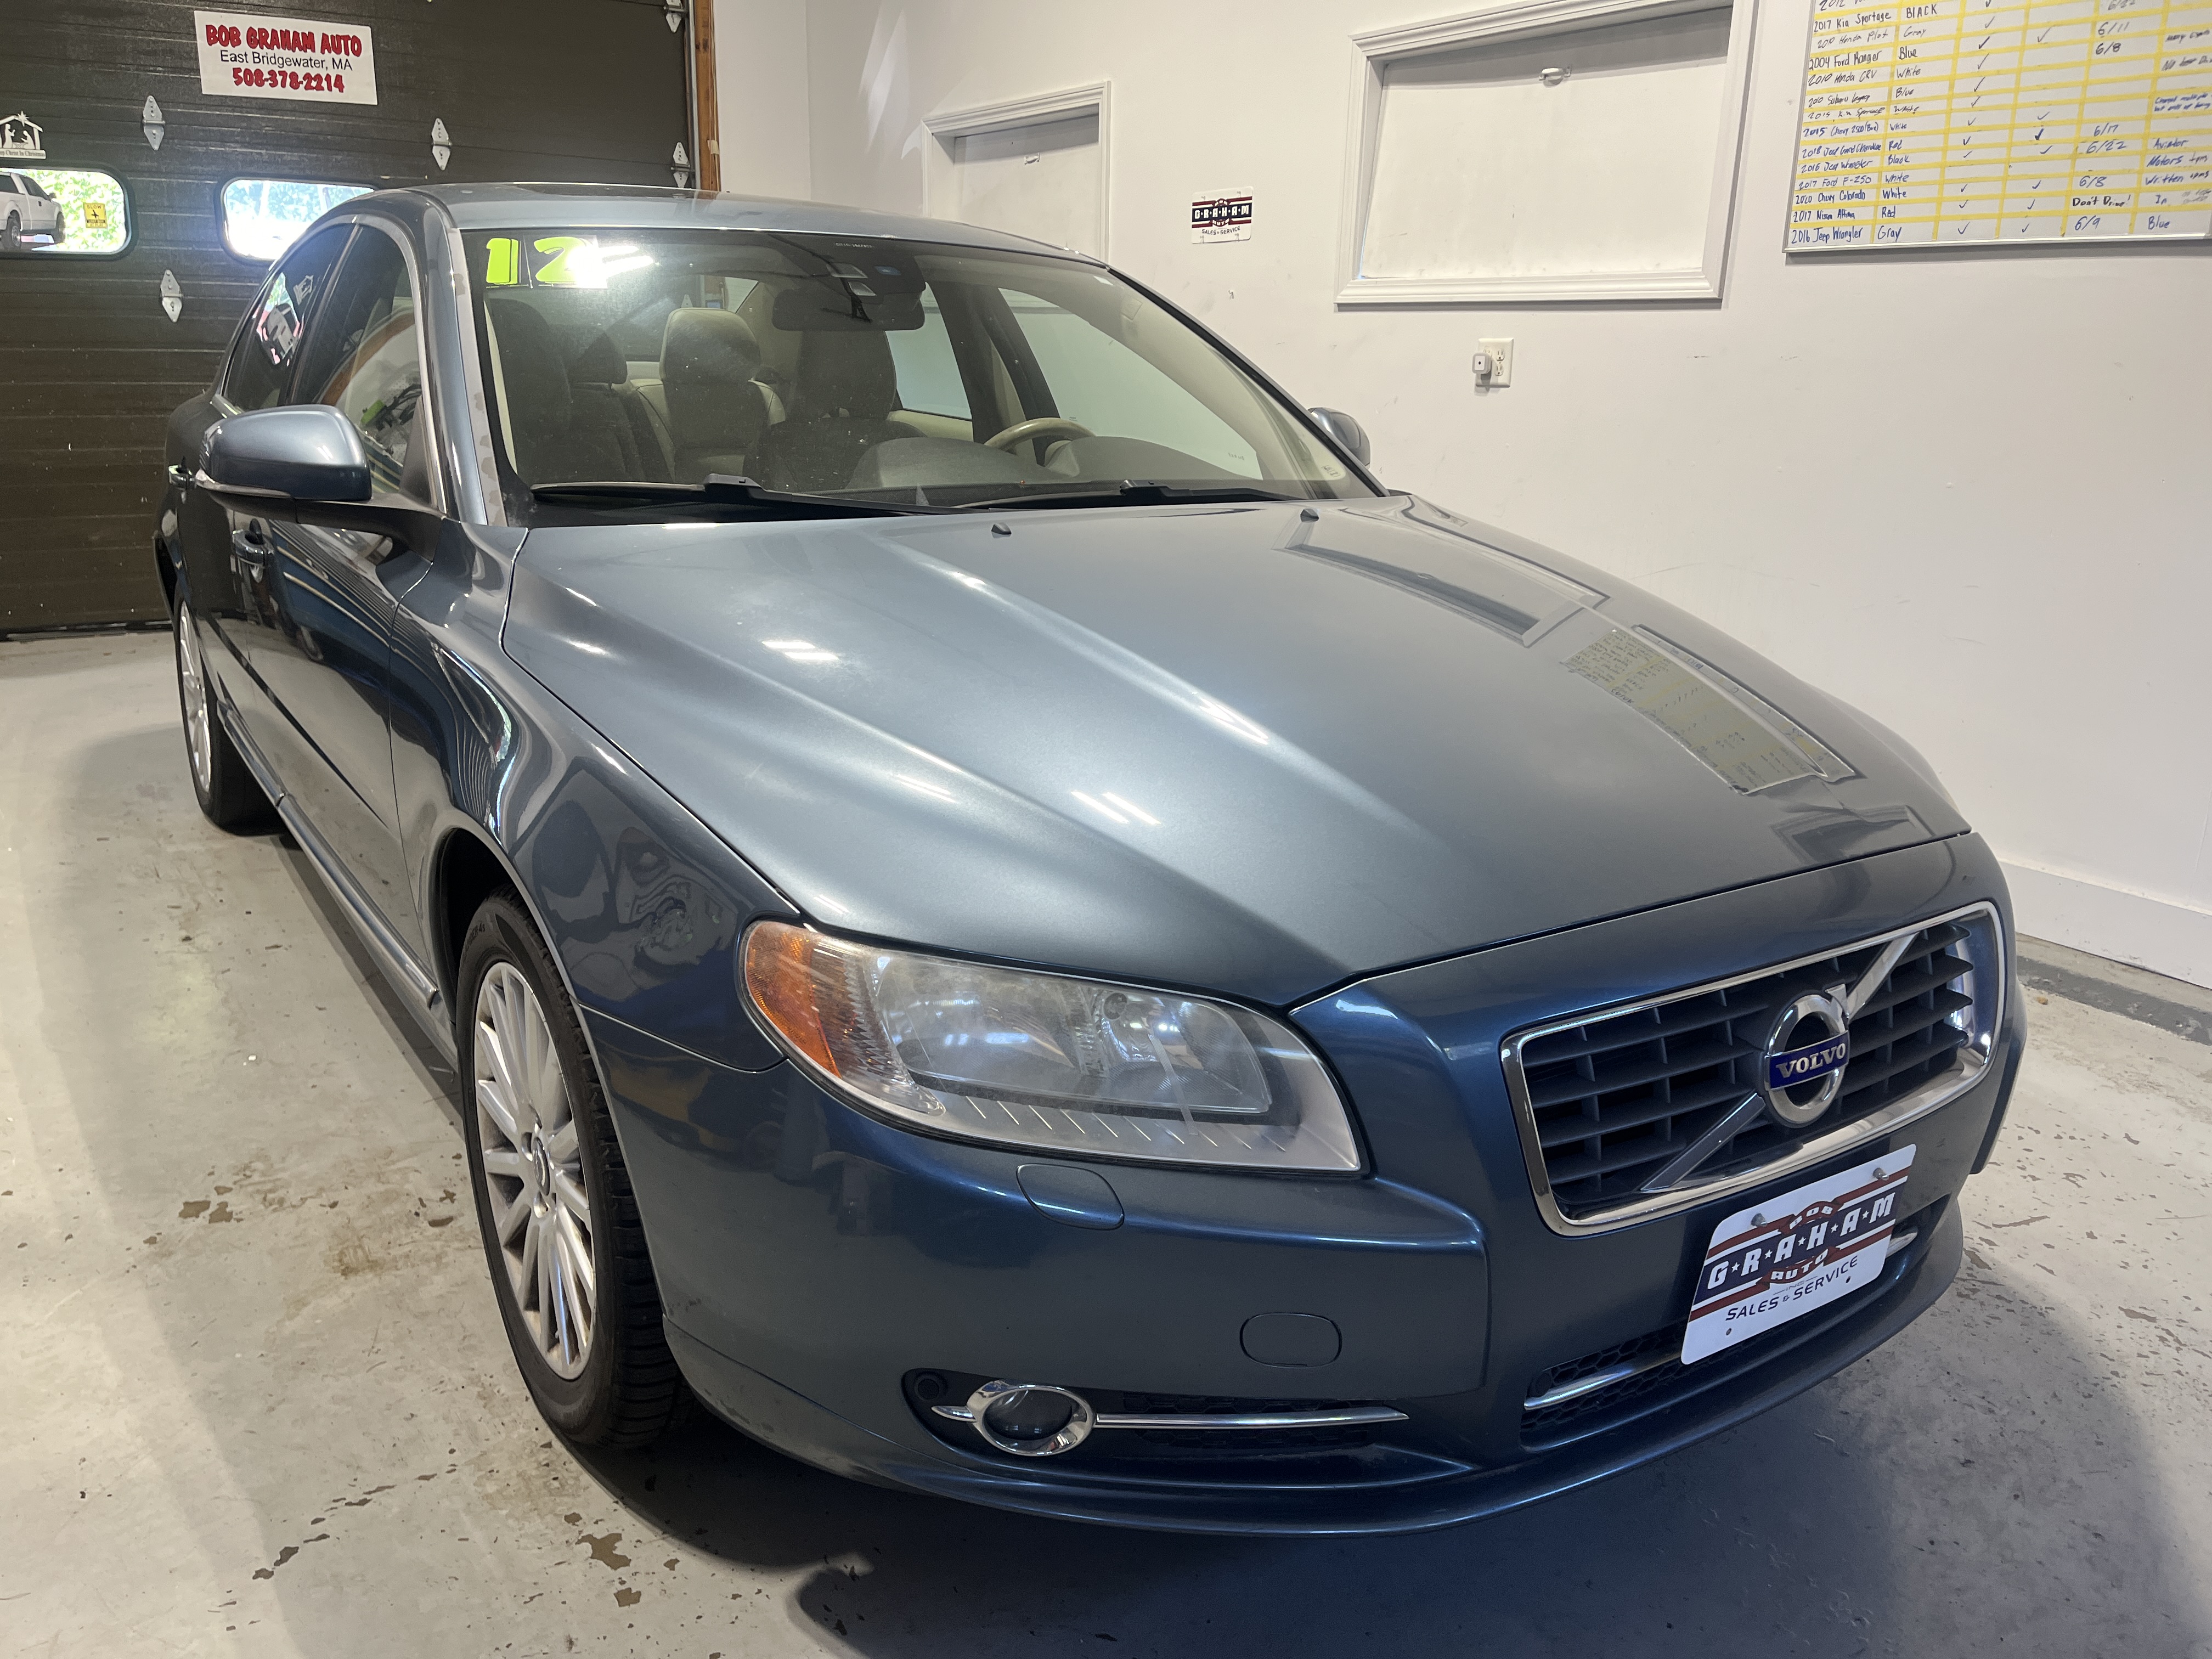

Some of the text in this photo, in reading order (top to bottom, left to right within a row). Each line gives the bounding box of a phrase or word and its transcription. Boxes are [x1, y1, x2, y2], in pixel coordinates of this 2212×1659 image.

[1814, 12, 1891, 32] 2017 Kia Sportage
[2098, 22, 2130, 35] 6/11
[205, 25, 362, 57] BOB GRAHAM AUTO
[1839, 35, 1862, 44] Honda
[1899, 46, 1917, 60] Blue
[2096, 42, 2121, 55] 6/8
[220, 50, 353, 71] East Bridgewater, MA
[1809, 50, 1882, 71] 2004 Ford Ranger
[1808, 70, 1877, 86] 2010 Honda CRV
[1897, 65, 1921, 78] White
[233, 67, 345, 93] 508-378-2214
[1896, 87, 1914, 98] Blue
[1803, 127, 1827, 137] 2015
[1889, 122, 1907, 131] White
[2094, 122, 2119, 137] 6/17
[1888, 139, 1903, 151] Red
[2086, 140, 2126, 154] 6/22
[1802, 146, 1822, 159] 2018
[1888, 154, 1910, 165] Black
[1801, 163, 1821, 174] 2016
[1799, 174, 1872, 190] 2017 Ford F-250
[1885, 172, 1909, 183] White
[2079, 175, 2107, 188] 6/8
[1796, 195, 1812, 205] 2020
[1839, 189, 1865, 201] Colorado
[1882, 187, 1906, 199] White
[1194, 205, 1249, 219] GRAHAM
[1793, 210, 1811, 223] 2017
[1882, 205, 1895, 218] Red
[2075, 215, 2101, 230] 6/9
[2148, 215, 2170, 230] Blue
[1220, 225, 1240, 235] SERVICE
[1791, 225, 1864, 244] 2016 Jeep Wrangler
[1877, 225, 1902, 242] Gray
[486, 236, 603, 284] 12
[1775, 1043, 1847, 1079] VOLVO
[1789, 1205, 1833, 1229] BOB
[1707, 1192, 1895, 1290] GRAHAM
[1770, 1248, 1829, 1280] AUTO
[1725, 1296, 1780, 1321] SALES
[1792, 1255, 1858, 1301] SERVICE
